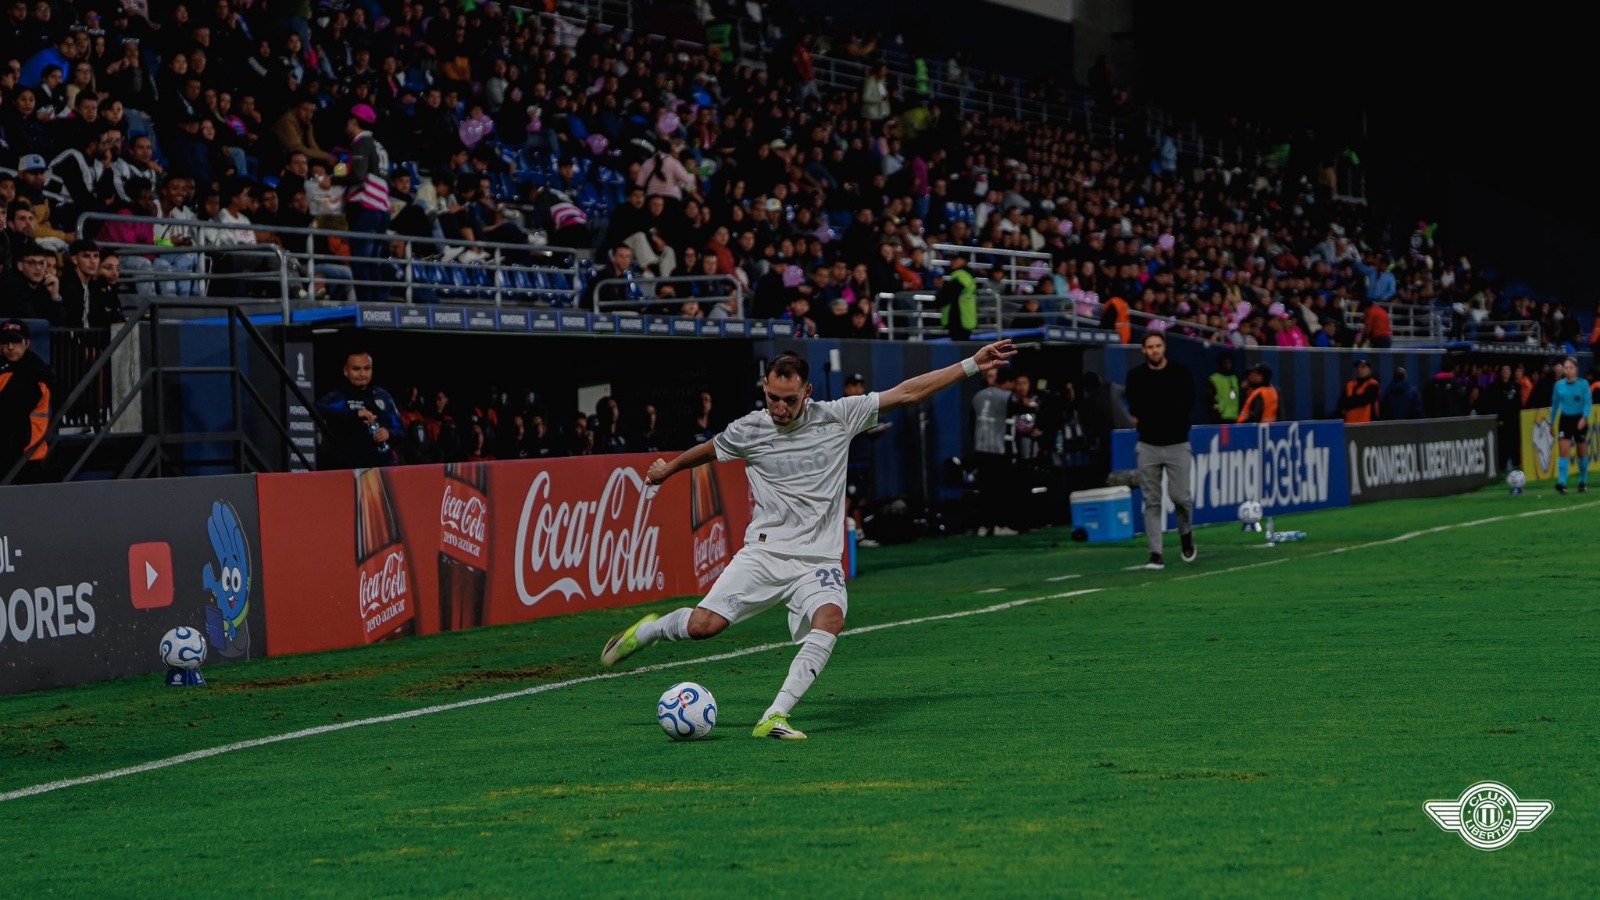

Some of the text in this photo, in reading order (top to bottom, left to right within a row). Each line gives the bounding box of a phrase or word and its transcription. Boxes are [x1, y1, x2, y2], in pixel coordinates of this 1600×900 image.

[775, 445, 829, 478] tigo
[1362, 437, 1486, 487] CONMEBOL LIBERTADORES
[440, 484, 486, 542] Coca-Cola
[443, 530, 457, 546] zero
[514, 466, 662, 606] Coca-Cola
[359, 551, 406, 619] Coca-Cola
[0, 582, 96, 643] ORES
[365, 613, 381, 633] zero
